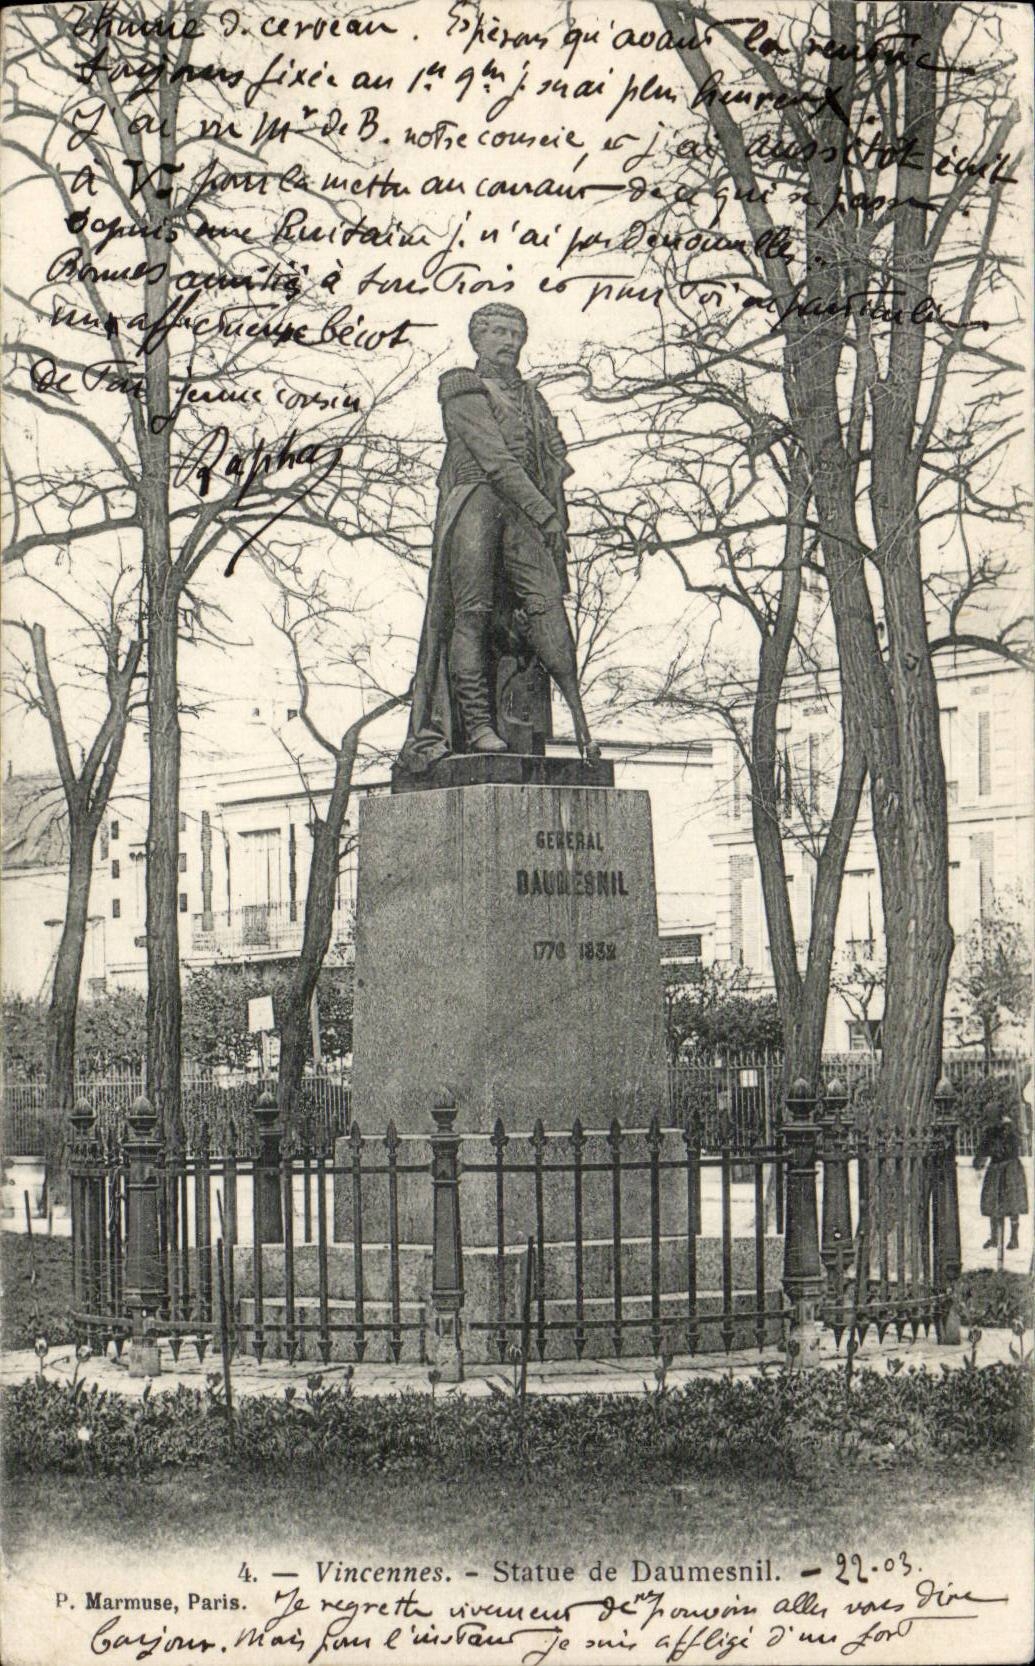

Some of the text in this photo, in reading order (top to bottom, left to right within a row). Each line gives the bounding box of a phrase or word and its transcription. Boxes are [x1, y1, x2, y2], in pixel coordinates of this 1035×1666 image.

[352, 71, 393, 89] au
[421, 176, 465, 196] au
[516, 869, 629, 896] DAUMESNIL
